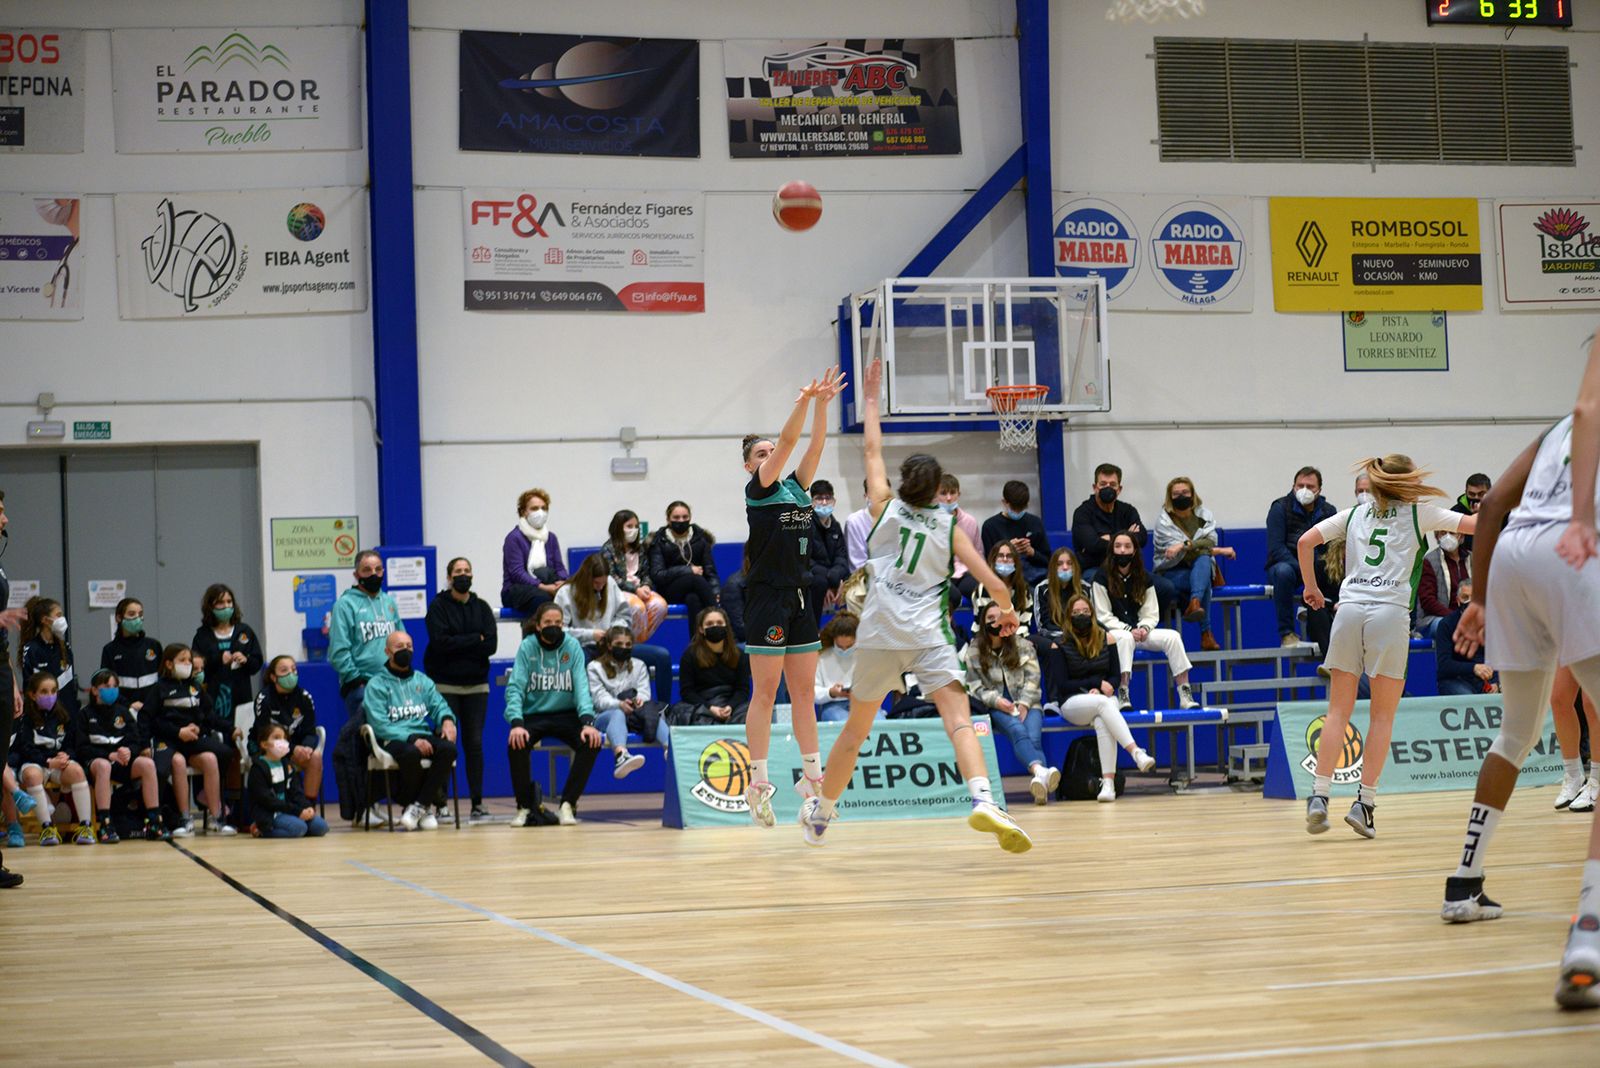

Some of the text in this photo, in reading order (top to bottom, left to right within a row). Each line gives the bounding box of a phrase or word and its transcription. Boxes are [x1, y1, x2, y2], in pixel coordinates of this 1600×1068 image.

[156, 65, 176, 77] EL
[772, 63, 908, 91] TALLERES ABC
[156, 79, 321, 103] PARADOR
[760, 97, 790, 107] TALLER
[791, 97, 803, 107] DE
[862, 96, 873, 106] DE
[157, 105, 320, 116] RESTAURANTE
[496, 112, 665, 134] AMACOSTA
[841, 114, 856, 125] EN
[859, 112, 907, 125] GENERAL
[204, 123, 272, 146] Pueblo
[760, 131, 868, 142] WWW.TALLERESABC.COM
[814, 142, 847, 151] ESTEPONA
[571, 202, 642, 215] Fernández
[571, 215, 650, 229] & Asociados
[1065, 221, 1119, 236] RADIO
[1171, 224, 1223, 239] RADIO
[1351, 221, 1468, 237] ROMBOSOL
[265, 249, 350, 268] FIBA Agent
[1059, 241, 1128, 264] MARCA
[1165, 244, 1233, 265] MARCA
[1363, 259, 1394, 269] NUEVO
[1418, 259, 1470, 269] SEMINUEVO
[1543, 262, 1596, 271] JARDINES
[1287, 271, 1339, 282] RENAULT
[1363, 270, 1404, 281] OCASIÓN
[263, 280, 356, 295] www.jpsportsagency.com
[485, 291, 536, 301] 951 316 714
[552, 292, 603, 301] 649 064 676
[644, 292, 697, 304] info@ffya.es
[1181, 294, 1217, 305] MÁLAGA
[1382, 316, 1409, 327] PISTA
[1369, 331, 1424, 343] LEONARDO
[1357, 345, 1437, 359] TORRES BENÍTEZ
[291, 525, 314, 534] ZONA
[284, 548, 326, 558] DE MANOS
[895, 526, 926, 575] 11
[1365, 529, 1388, 567] 5
[1440, 706, 1502, 731] CAB
[1462, 806, 1489, 868] ELITE
